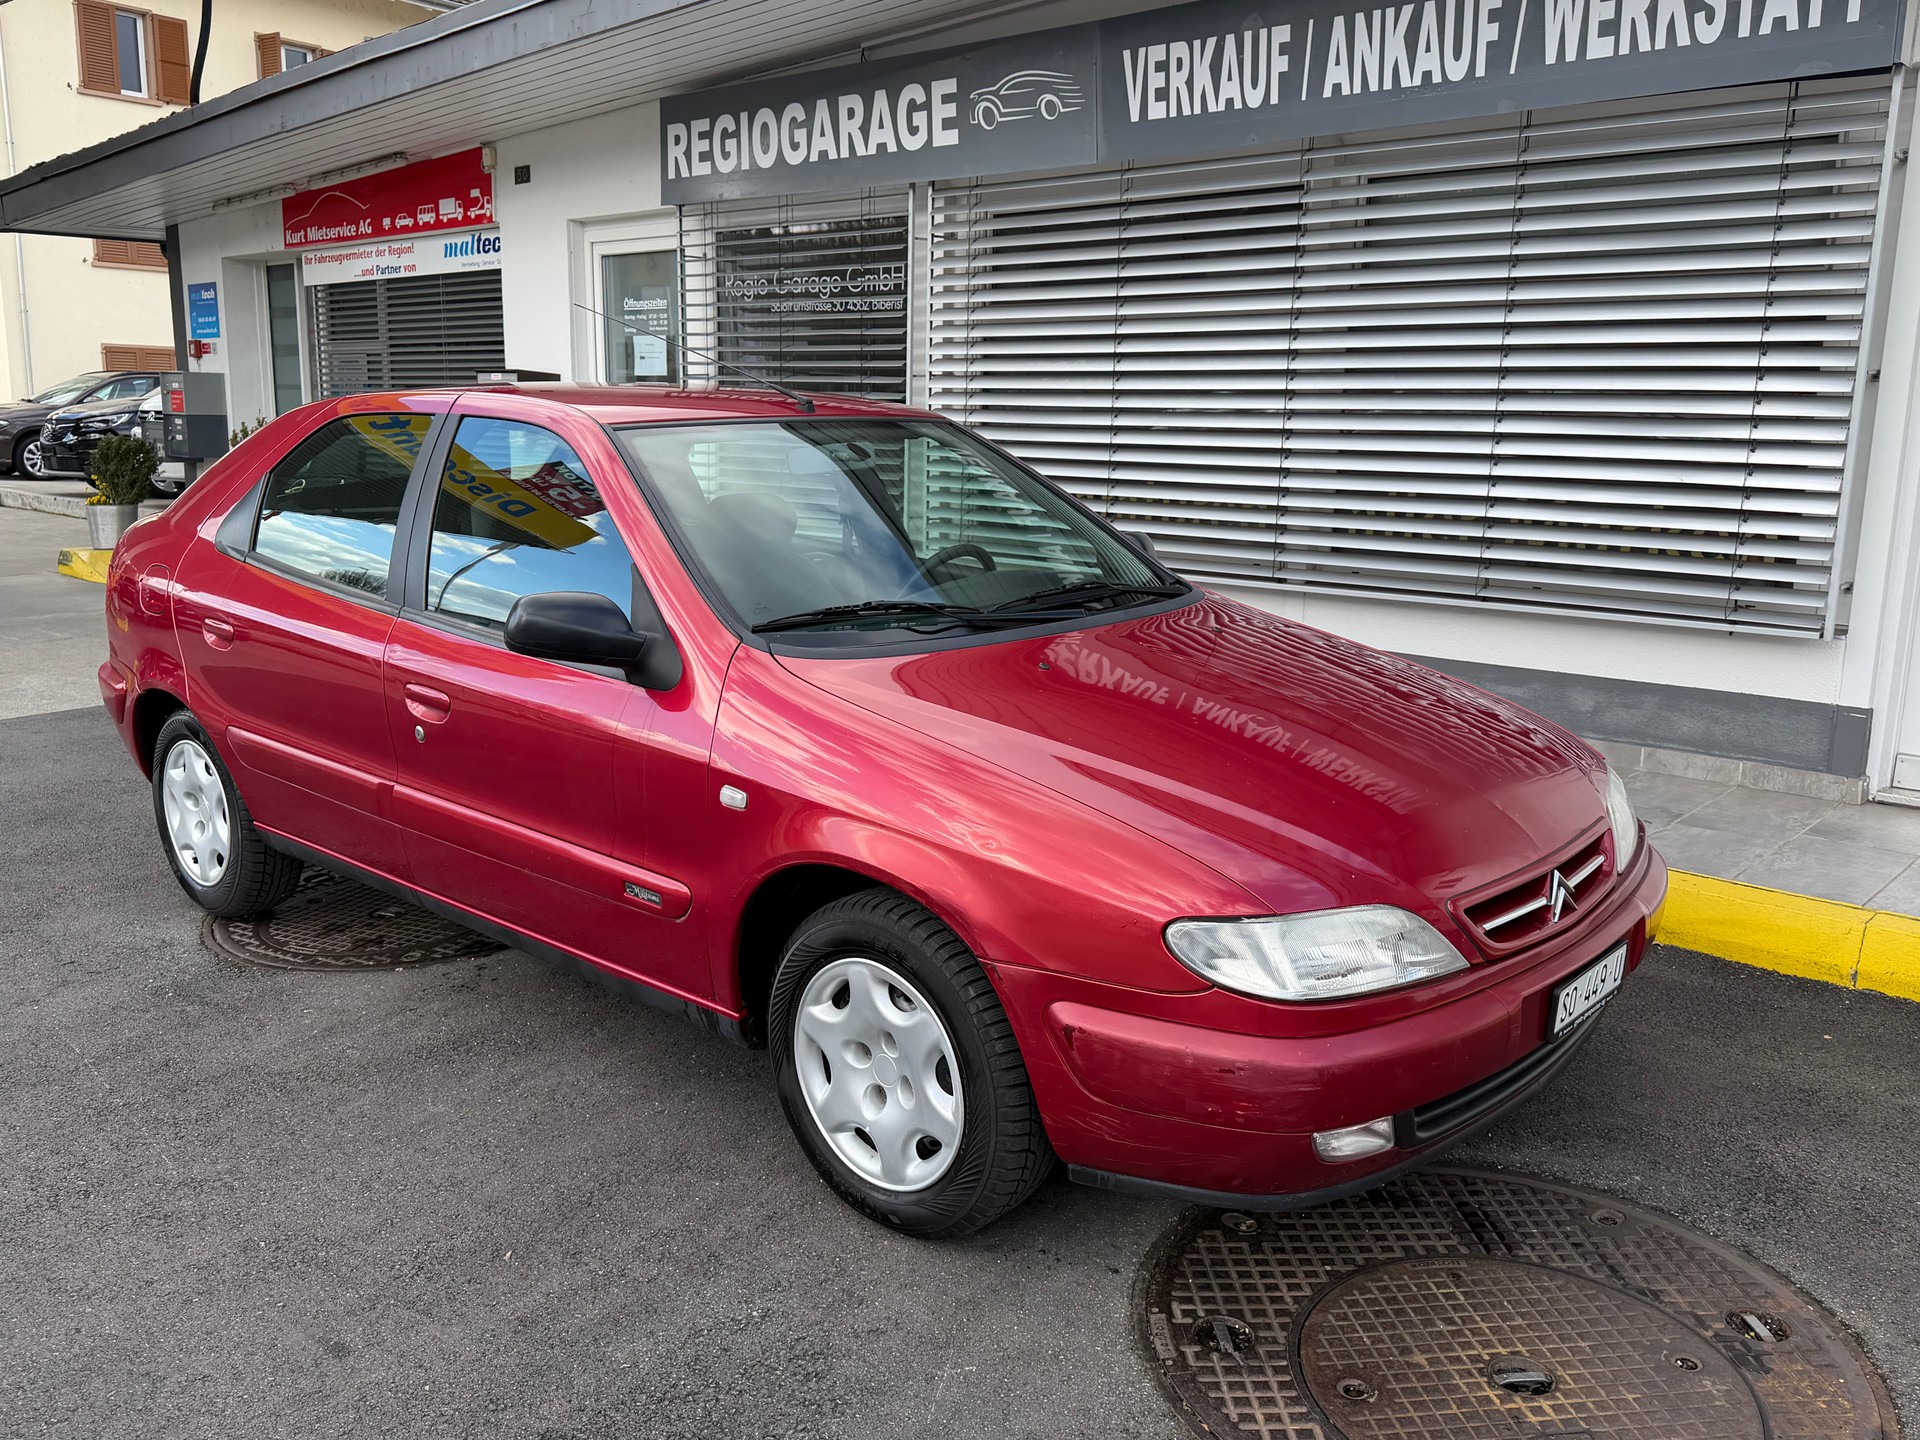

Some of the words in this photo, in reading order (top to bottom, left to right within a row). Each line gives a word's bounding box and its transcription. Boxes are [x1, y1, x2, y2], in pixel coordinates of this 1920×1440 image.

[1123, 23, 1291, 122] VERKAUF
[1301, 19, 1314, 101] /
[1323, 0, 1502, 98] ANKAUF
[667, 77, 959, 180] REGIOGARAGE
[286, 229, 305, 245] Kurt
[307, 223, 357, 242] Mietservice
[358, 218, 372, 234] AG
[303, 255, 313, 265] Ihr
[314, 249, 373, 265] Fahrzeugvermieter
[375, 246, 387, 258] der
[388, 242, 415, 258] Region!
[375, 264, 402, 275] Partner
[403, 264, 416, 273] von
[725, 274, 768, 301] Regio
[773, 268, 842, 299] Garage
[846, 262, 905, 292] GmbH
[624, 297, 667, 310] Öffnungszeiten
